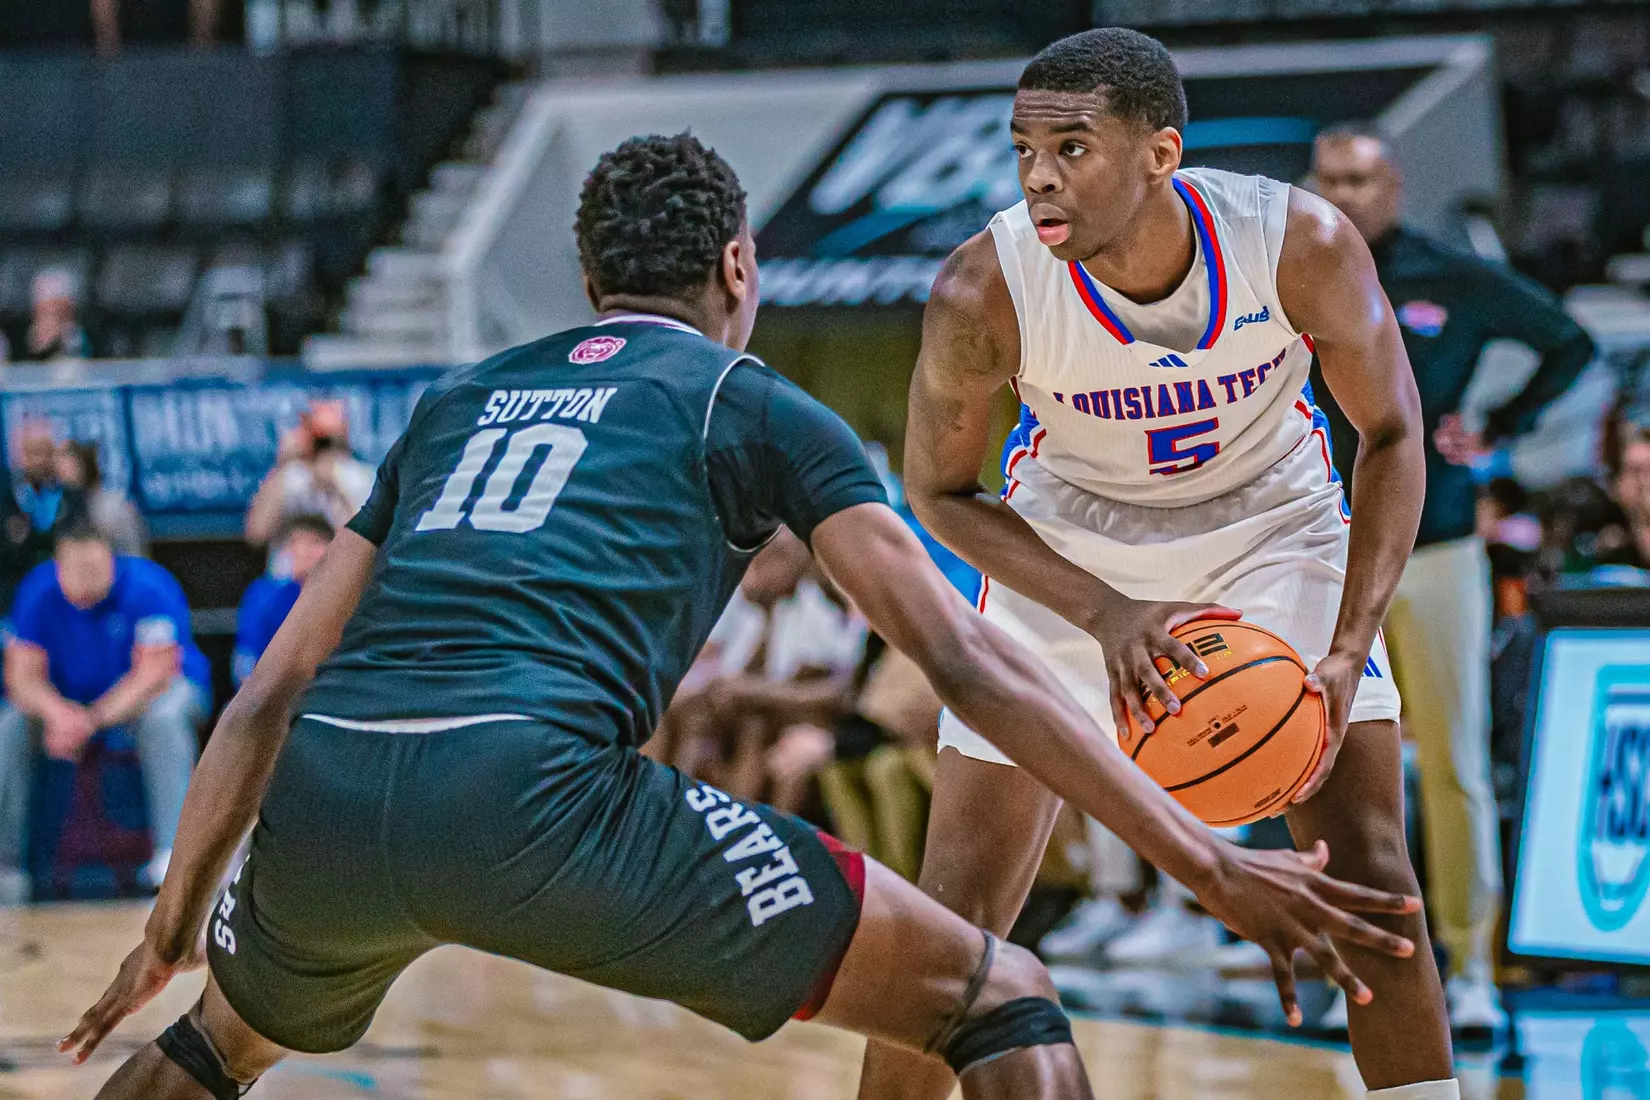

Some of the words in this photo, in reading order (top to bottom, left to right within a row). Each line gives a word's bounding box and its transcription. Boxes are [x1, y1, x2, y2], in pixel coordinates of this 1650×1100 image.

[477, 387, 618, 426] SUTTON
[1145, 416, 1220, 475] 5
[415, 423, 589, 533] 10
[685, 783, 814, 927] BEARS
